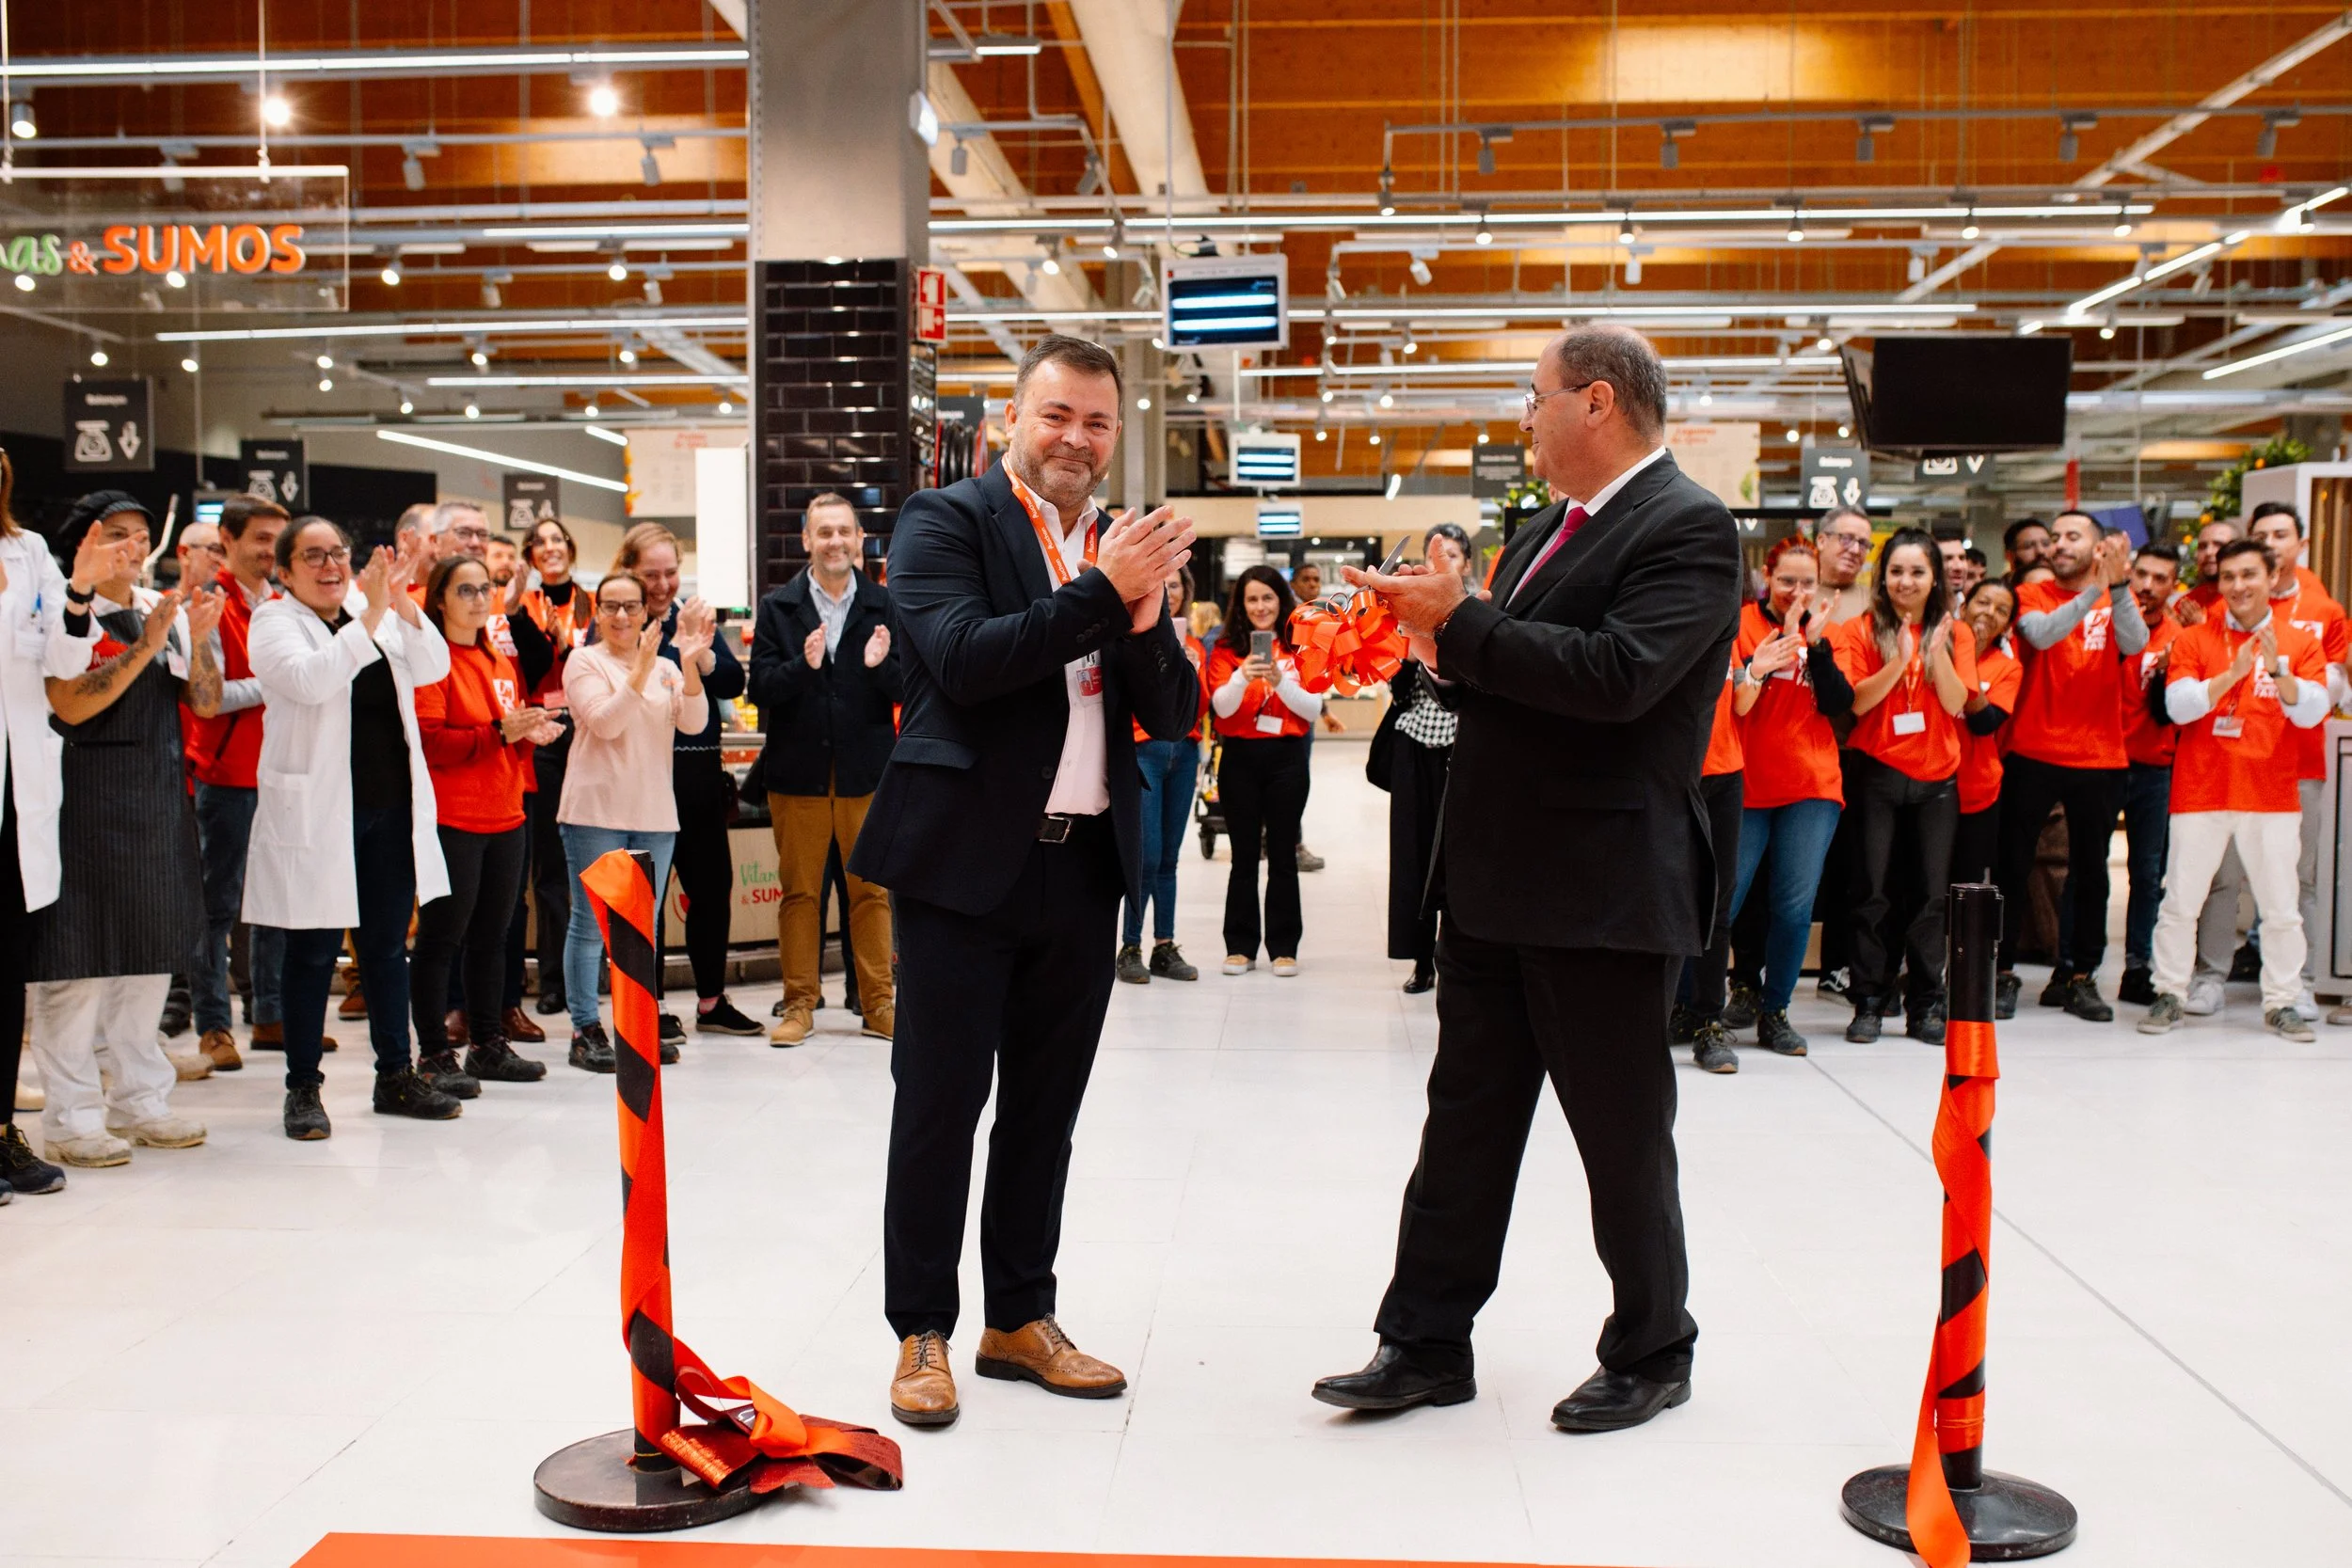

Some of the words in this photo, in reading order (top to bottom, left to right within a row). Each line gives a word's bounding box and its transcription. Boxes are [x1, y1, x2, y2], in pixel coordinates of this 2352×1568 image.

[0, 233, 62, 276] as
[67, 241, 98, 276] &
[102, 223, 306, 275] SUMOS
[1025, 496, 1040, 518] Auchan
[1040, 526, 1055, 550] Auchan
[1087, 532, 1095, 553] Auchan
[1056, 558, 1070, 581] Auchan
[739, 860, 780, 887] Vitam
[752, 887, 784, 904] SUM
